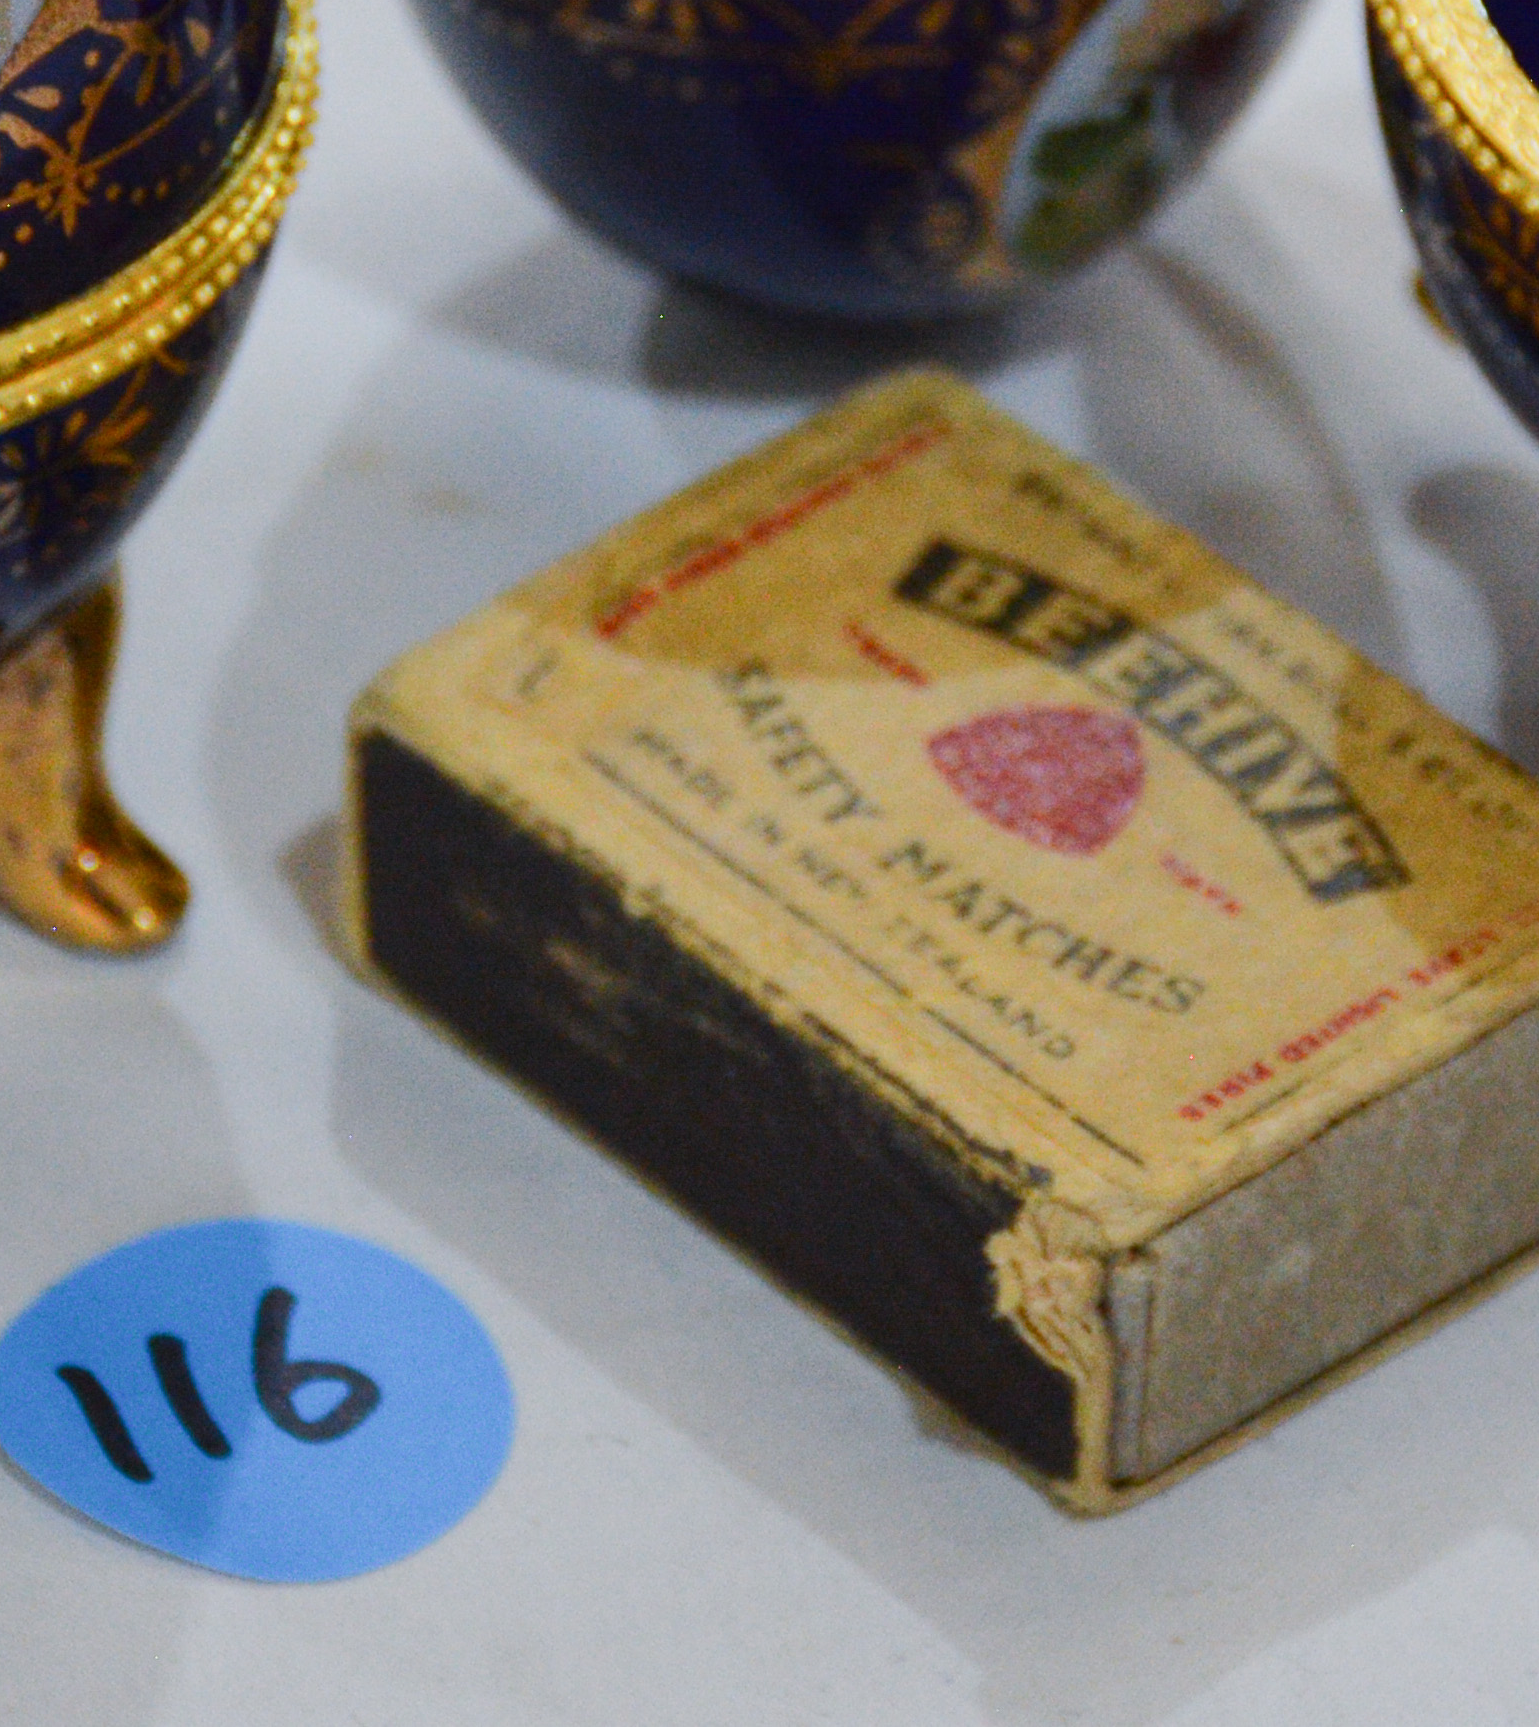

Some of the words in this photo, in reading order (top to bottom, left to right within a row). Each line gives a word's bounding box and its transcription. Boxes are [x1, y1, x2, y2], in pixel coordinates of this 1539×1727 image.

[718, 657, 882, 824] SAFETY
[878, 839, 1206, 1017] MATCHES
[896, 534, 1410, 902] BEEHIVE
[55, 1284, 382, 1486] 116
